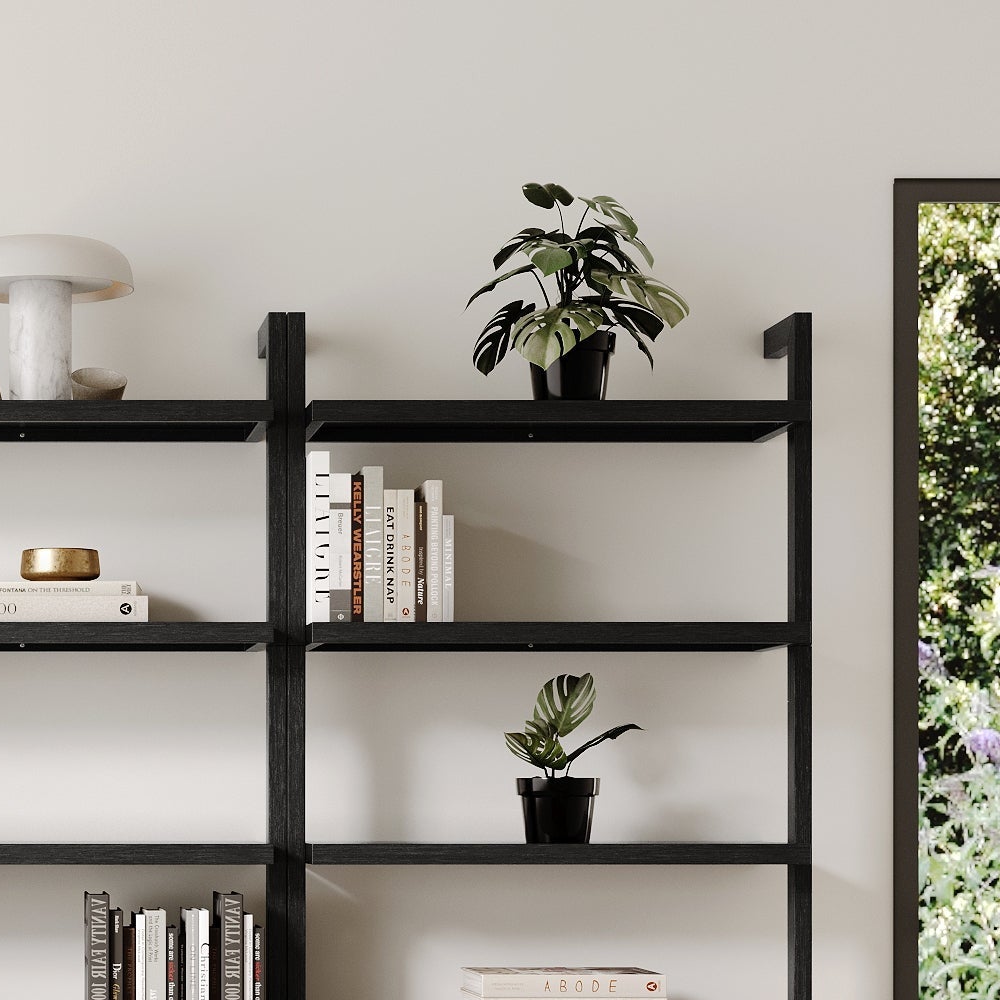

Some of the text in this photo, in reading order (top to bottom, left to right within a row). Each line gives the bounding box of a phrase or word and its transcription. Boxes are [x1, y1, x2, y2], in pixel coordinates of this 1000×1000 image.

[431, 506, 439, 541] PAINTING
[353, 481, 362, 615] KELLY WEARSTLER
[365, 506, 381, 584] LIAIGRE
[386, 507, 394, 604] EAT DRINK NAP
[431, 543, 439, 571] BEYOND
[417, 577, 425, 605] Nature
[431, 573, 439, 606] POLLOCK
[112, 963, 122, 980] Dior
